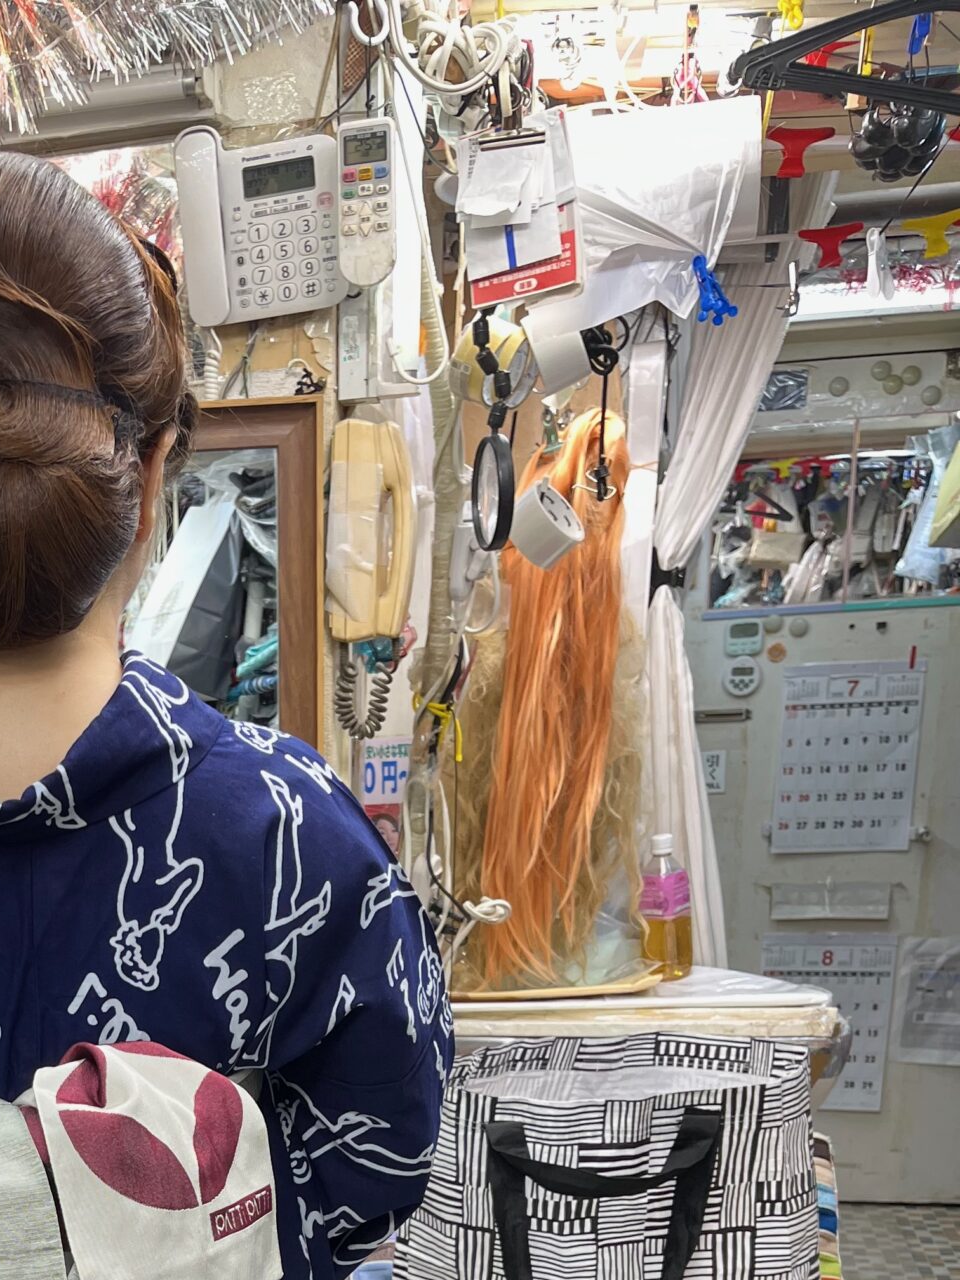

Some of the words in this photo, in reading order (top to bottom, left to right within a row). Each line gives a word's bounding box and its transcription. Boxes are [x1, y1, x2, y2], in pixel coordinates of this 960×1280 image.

[254, 227, 262, 240] 1
[278, 222, 287, 236] 2
[301, 218, 311, 232] 3
[256, 248, 265, 261] 4
[280, 244, 289, 258] 5
[303, 240, 313, 253] 6
[257, 269, 266, 282] 7
[281, 265, 291, 279] 8
[304, 261, 314, 275] 9
[283, 286, 292, 299] 0
[847, 680, 860, 697] 7
[821, 949, 834, 967] 8
